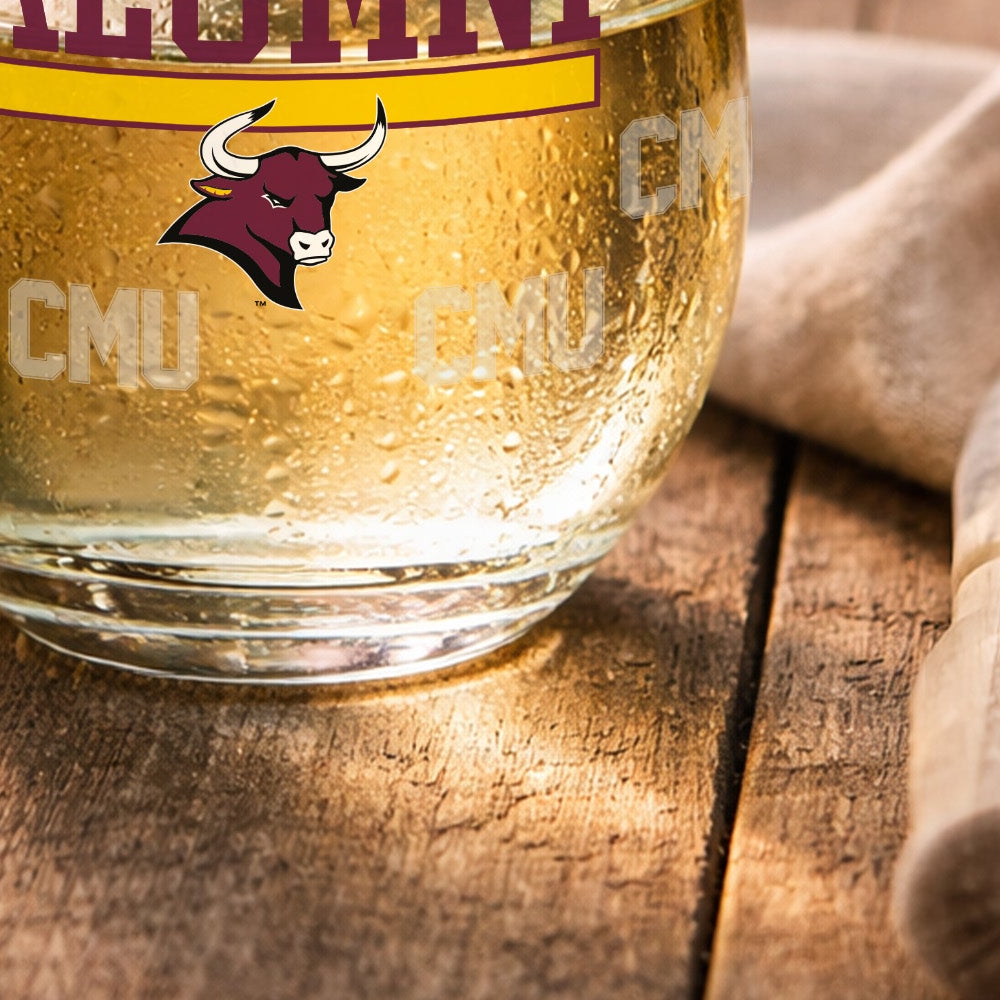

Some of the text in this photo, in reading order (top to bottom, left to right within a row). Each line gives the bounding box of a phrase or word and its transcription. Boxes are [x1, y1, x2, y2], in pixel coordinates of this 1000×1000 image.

[620, 96, 753, 220] CM
[8, 277, 200, 391] CMU
[414, 266, 605, 386] CMU
